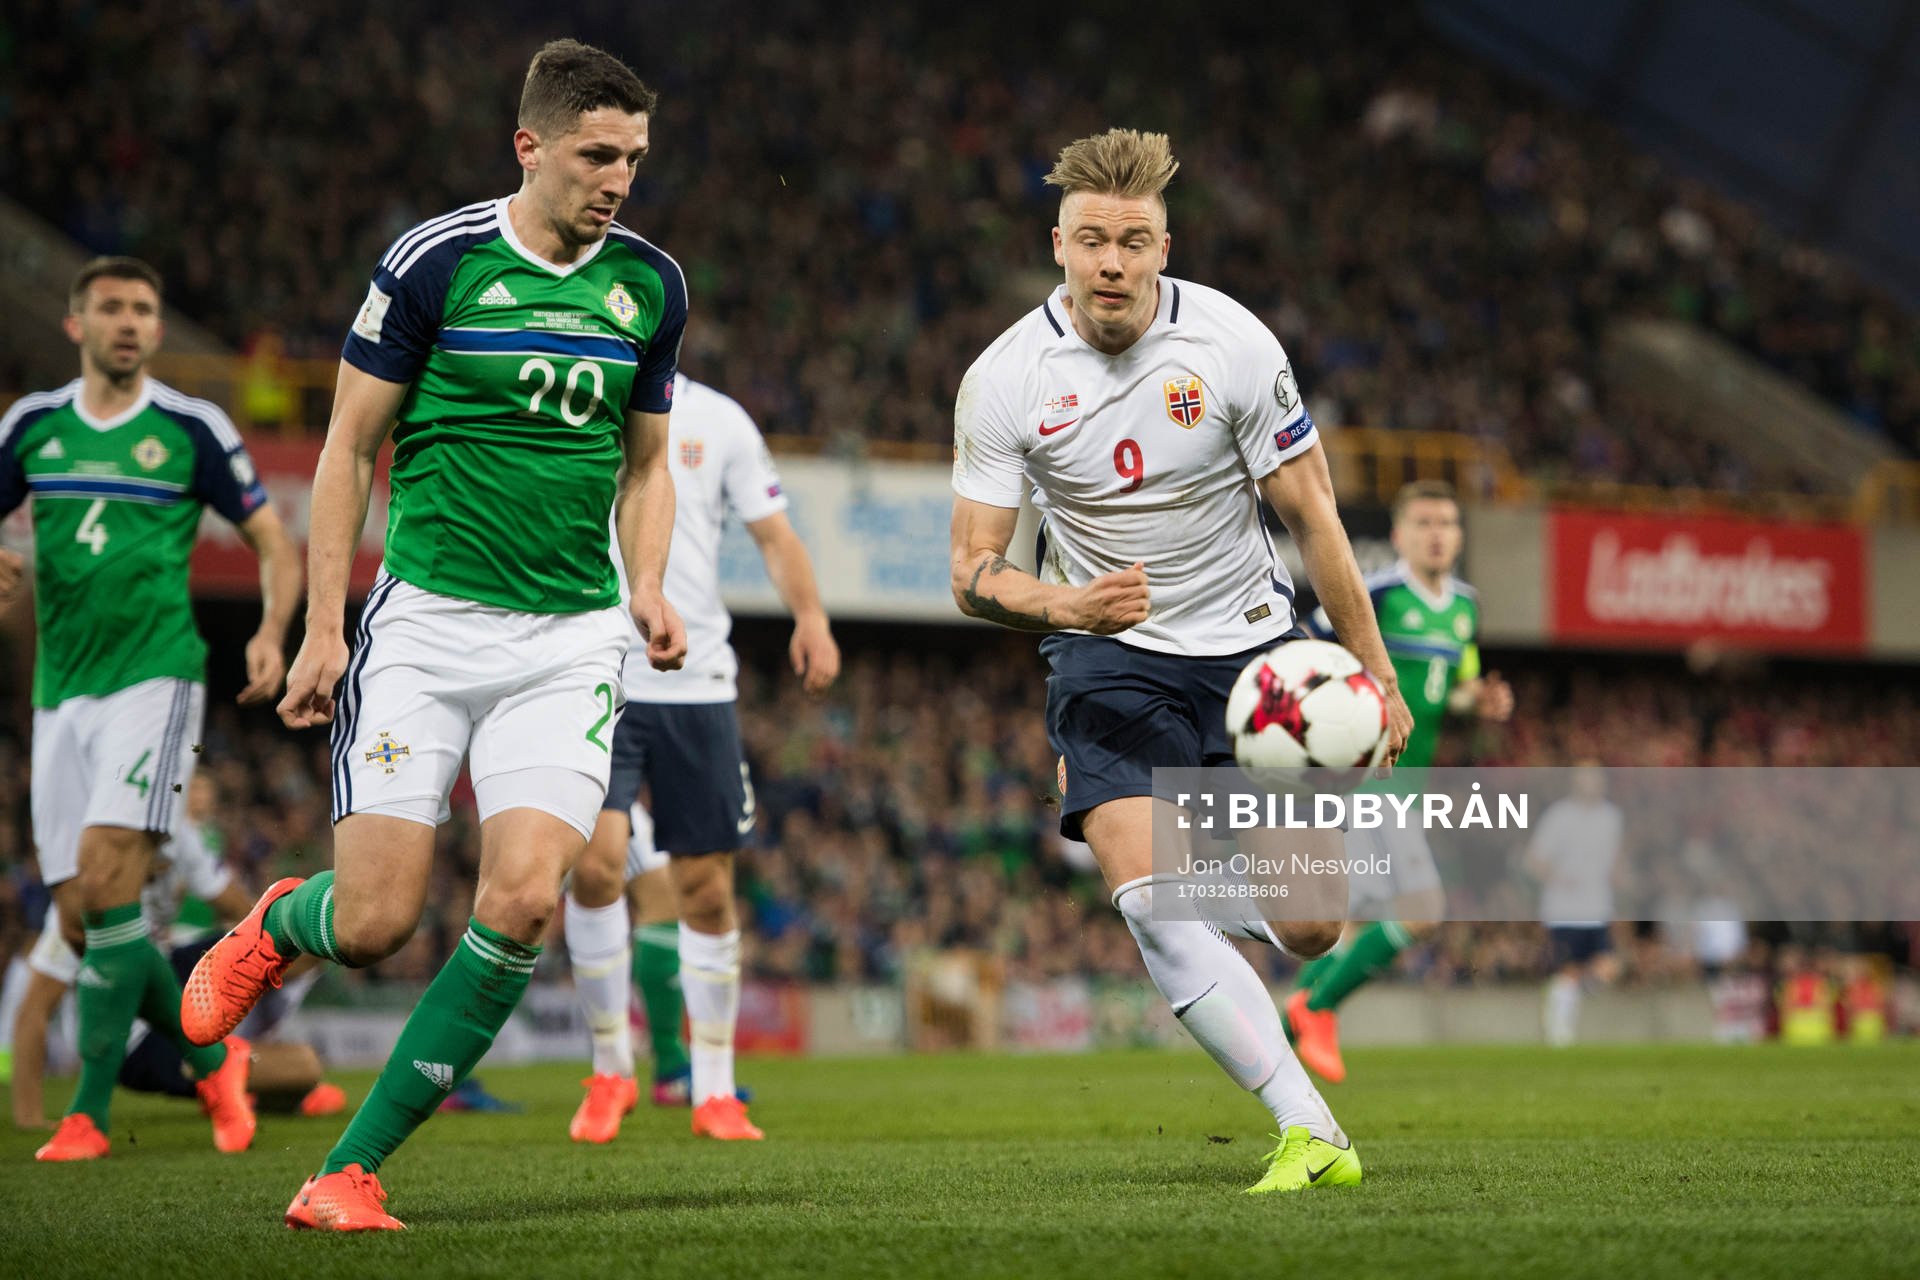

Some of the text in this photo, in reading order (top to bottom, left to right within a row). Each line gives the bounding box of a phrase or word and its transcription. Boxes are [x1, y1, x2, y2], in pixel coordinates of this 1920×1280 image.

[478, 296, 517, 305] adidas
[516, 358, 604, 427] 20
[1113, 438, 1143, 493] 9
[75, 496, 109, 555] 4
[125, 749, 151, 798] 4
